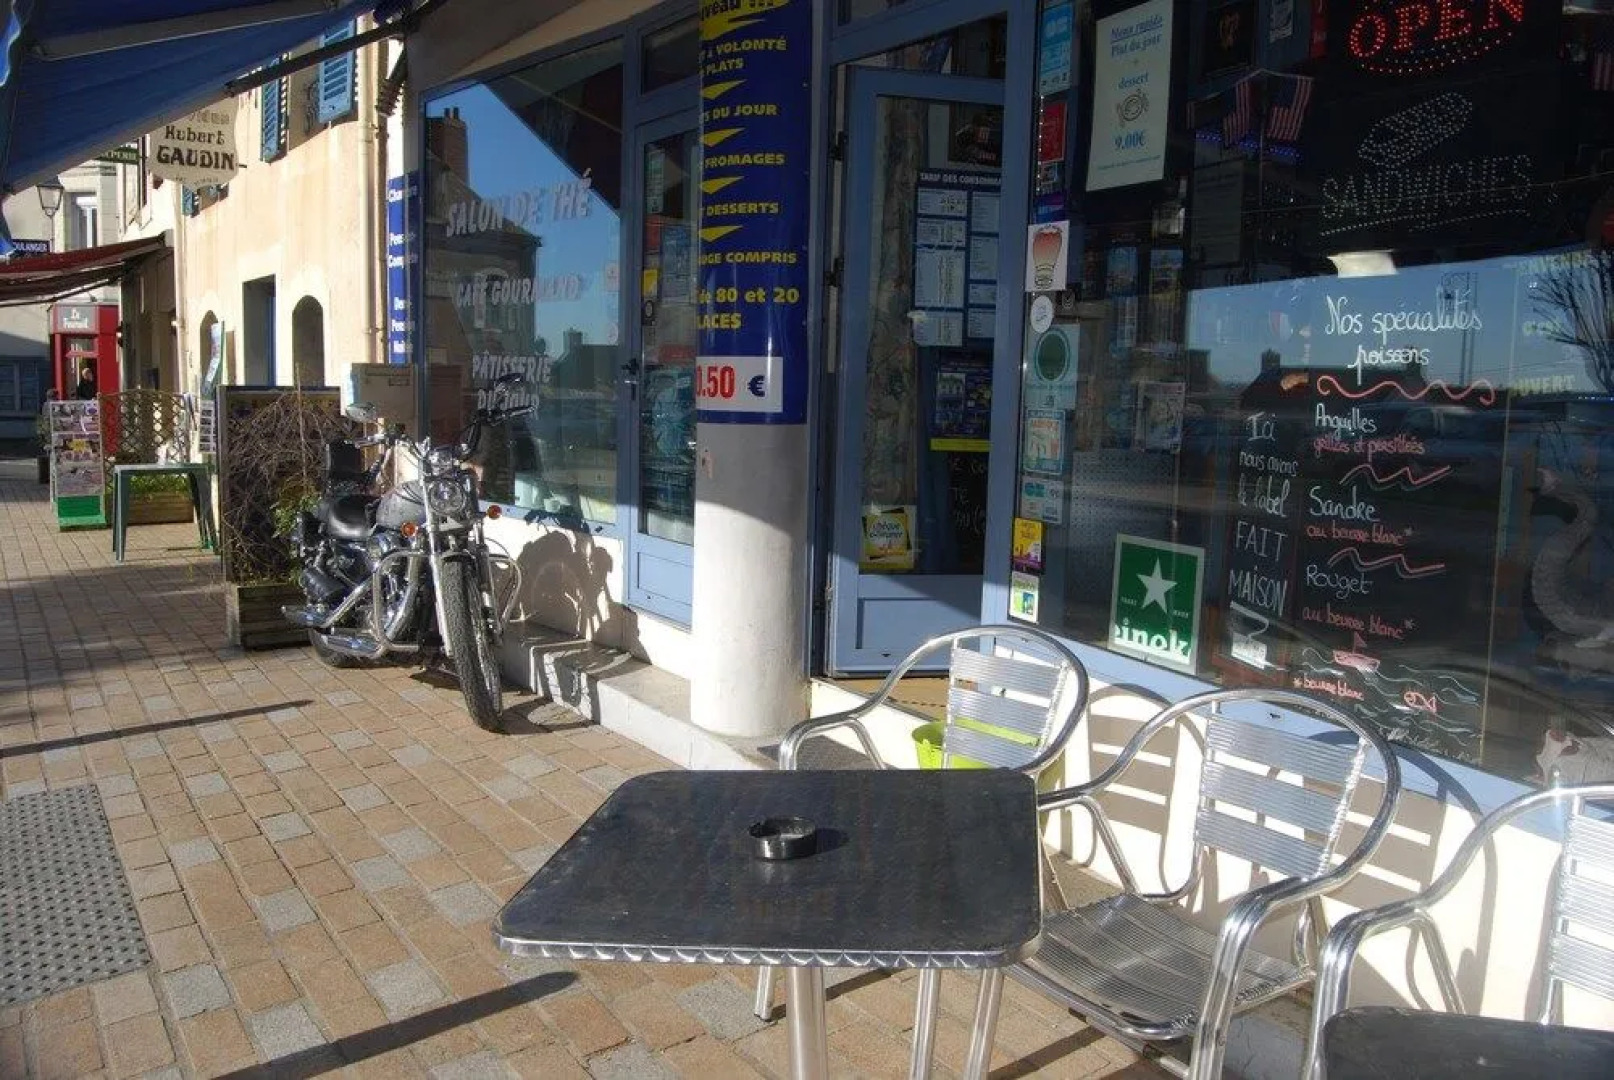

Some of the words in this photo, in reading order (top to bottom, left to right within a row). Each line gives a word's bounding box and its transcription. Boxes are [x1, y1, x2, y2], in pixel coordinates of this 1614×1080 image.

[1349, 0, 1525, 59] OPEN
[716, 35, 787, 56] VOLONTÉ
[706, 57, 743, 75] PLATS
[713, 106, 730, 119] DU
[734, 104, 777, 116] JOUR
[156, 144, 235, 171] GAUDIN
[704, 153, 785, 168] FROMAGES
[1320, 153, 1534, 222] SANDWICHES
[446, 199, 505, 238] SALON
[554, 167, 592, 221] THÉ
[706, 203, 779, 216] DESSERTS
[726, 252, 797, 264] COMPRIS
[716, 287, 738, 303] 80
[745, 288, 766, 303] et
[773, 288, 800, 304] 20
[1324, 294, 1364, 336] Nos
[747, 375, 766, 397] €
[1314, 402, 1378, 438] Anguilles
[1235, 520, 1288, 562] FAIT
[1305, 564, 1374, 600] Rouget
